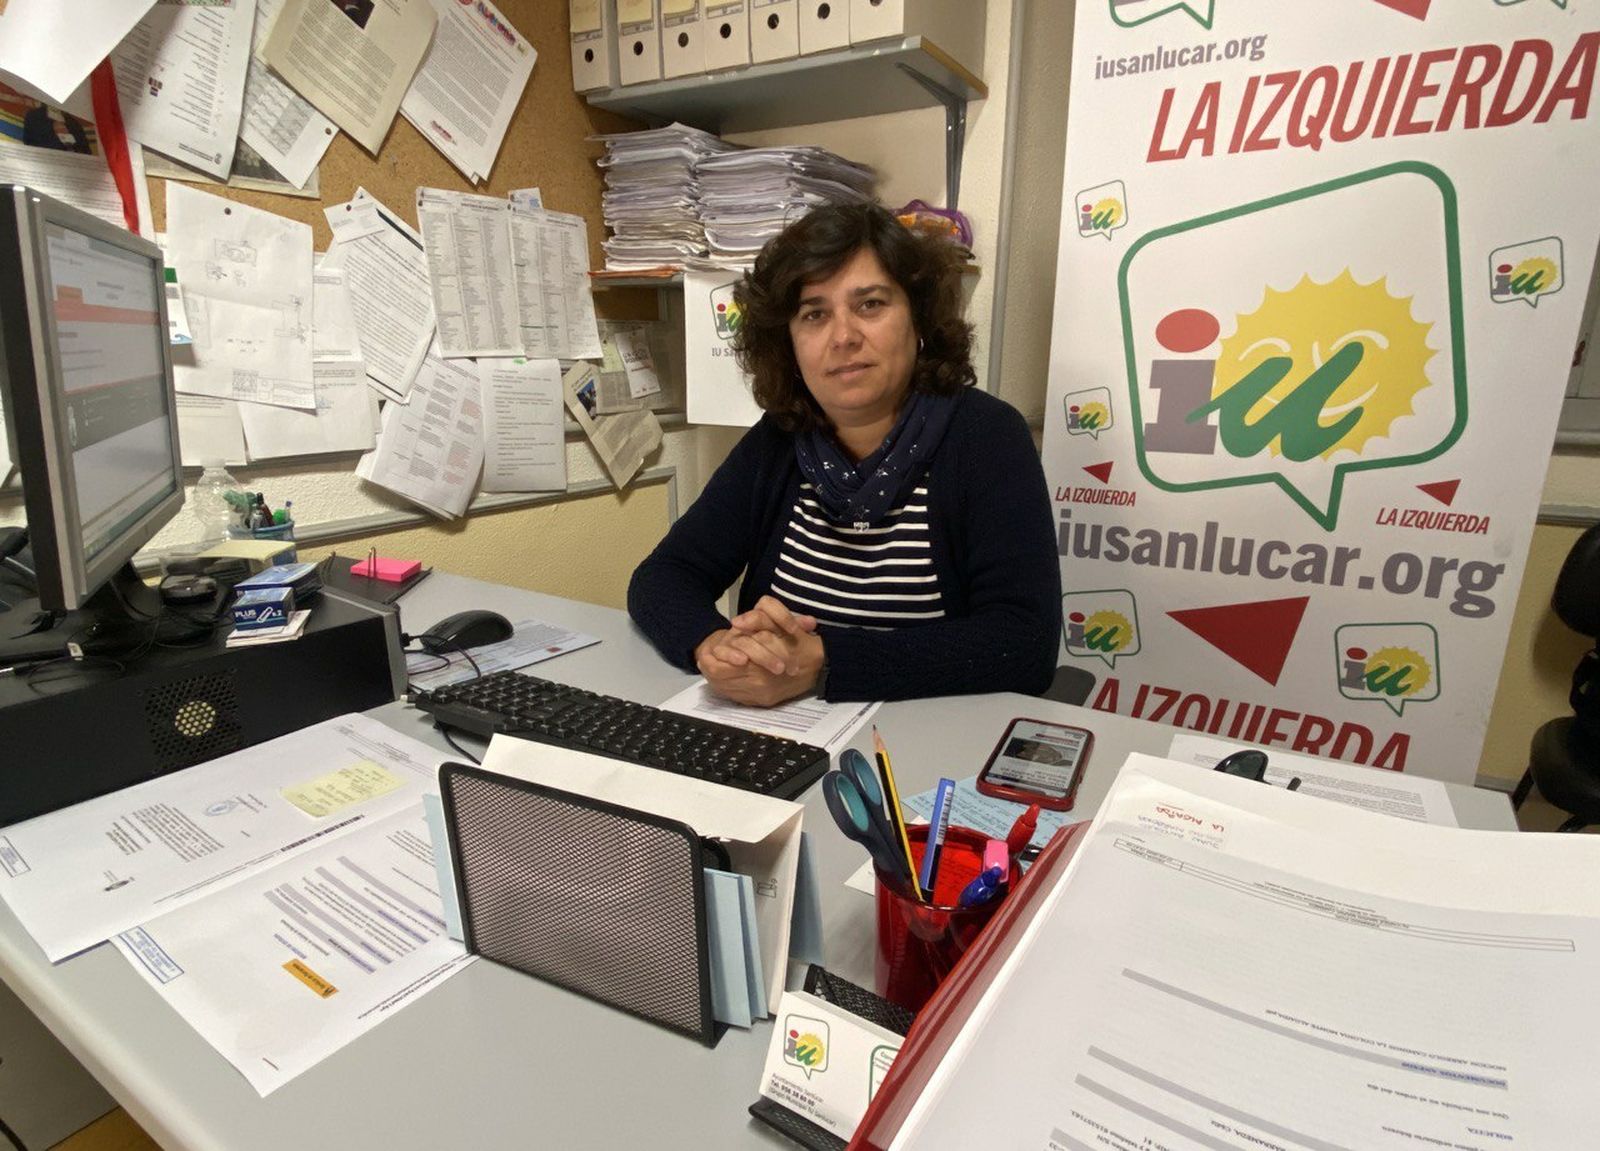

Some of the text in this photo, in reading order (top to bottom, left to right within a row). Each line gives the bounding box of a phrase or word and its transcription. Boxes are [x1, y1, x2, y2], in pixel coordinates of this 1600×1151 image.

[1095, 33, 1268, 81] iusanlucar.org
[1146, 31, 1600, 163] LA IZQUIERDA
[1072, 487, 1137, 507] IZQUIERDA
[1376, 507, 1491, 535] LA IZQUIERDA
[1057, 508, 1505, 619] iusanlucar.org
[234, 609, 257, 618] PLUS
[1131, 683, 1411, 773] IZQUIERDA
